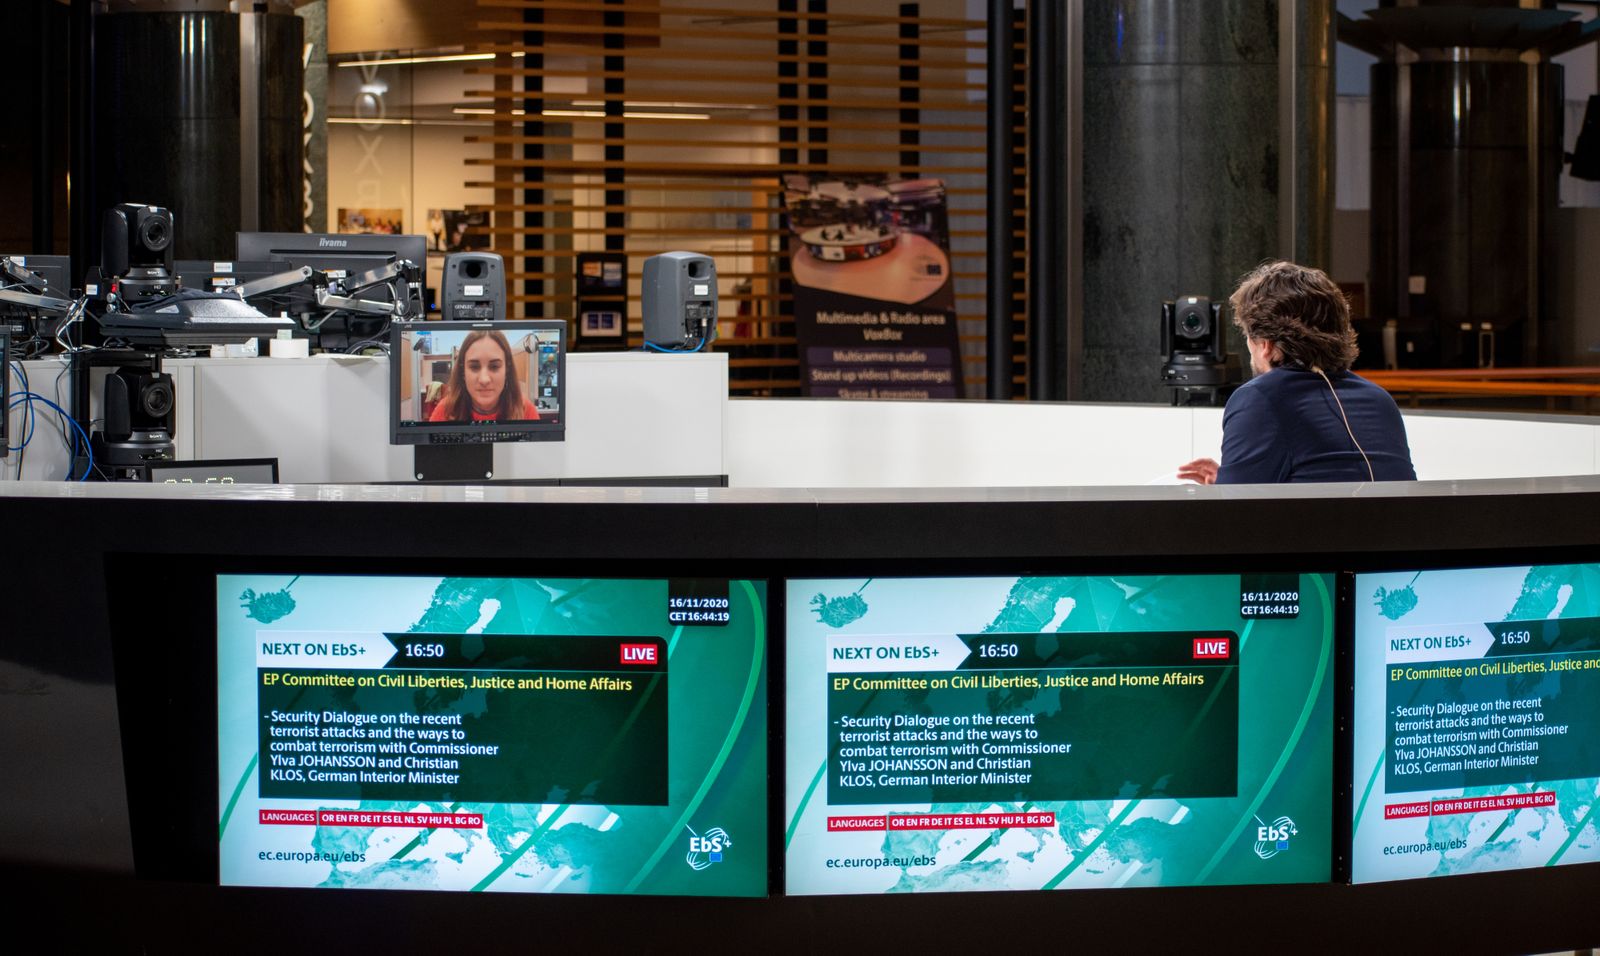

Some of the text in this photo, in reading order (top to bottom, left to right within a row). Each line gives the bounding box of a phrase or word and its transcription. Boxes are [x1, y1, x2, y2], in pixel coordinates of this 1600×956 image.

[816, 312, 946, 325] Multimedia & Radio area
[863, 328, 903, 341] VoxBox
[833, 351, 928, 363] Multicamera studio
[811, 370, 842, 381] Stand
[842, 373, 857, 383] up
[670, 598, 728, 608] 16/11/2020
[1242, 592, 1298, 602] 16/11/2020
[669, 612, 729, 621] CET 16:44:19
[1241, 605, 1299, 615] CET 16:44:19
[1391, 635, 1472, 650] NEXT ON EbS+
[1501, 631, 1530, 644] 16:50
[262, 643, 366, 656] NEXT ON EbS+
[405, 644, 444, 657] 16:50
[624, 648, 655, 660] LIVE
[833, 646, 939, 659] NEXT ON EbS+
[979, 644, 1018, 657] 16:50
[1197, 642, 1226, 654] LIVE
[1391, 659, 1582, 681] EP Committee on Civil Liberties, Justice
[263, 673, 632, 690] EP Committee on Civil Liberties, Justice and Home Affairs
[834, 672, 1204, 690] EP Committee on Civil Liberties, Justice and Home Affairs
[1396, 697, 1542, 717] Security Dialogue on the recent
[271, 710, 462, 726] Security Dialogue on the recent
[841, 713, 1035, 729] Security Dialogue on the recent
[1395, 712, 1544, 731] terrorist attacks and the ways to
[269, 726, 465, 742] terrorist attacks and the ways to
[840, 728, 1038, 742] terrorist attacks and the ways to
[1395, 725, 1568, 746] combat terrorism with Commissioner
[270, 741, 499, 755] combat terrorism with Commissioner
[840, 743, 1072, 757] combat terrorism with Commissioner
[1395, 740, 1538, 760] Ylva JOHANSSON and Christian
[270, 754, 458, 769] Ylva JOHANSSON and Christian
[840, 758, 1031, 772] Ylva JOHANSSON and Christian
[1395, 755, 1539, 775] KLOS, German Interior Minister
[270, 769, 460, 784] KLOS, German Interior Minister
[840, 772, 1032, 787] KLOS, German Interior Minister
[262, 813, 315, 821] LANGUAGES
[321, 814, 481, 825] OR EN FR DE IT ES EL NL SV HU PL BG RO
[830, 819, 887, 828] LANGUAGES
[1257, 826, 1298, 841] EbS+
[690, 836, 732, 852] EbS+
[1383, 838, 1467, 855] ec.europa.eu/ebs
[258, 850, 366, 865] ec.europa.eu/ebs
[826, 855, 936, 870] ec.europa.eu/ebs
